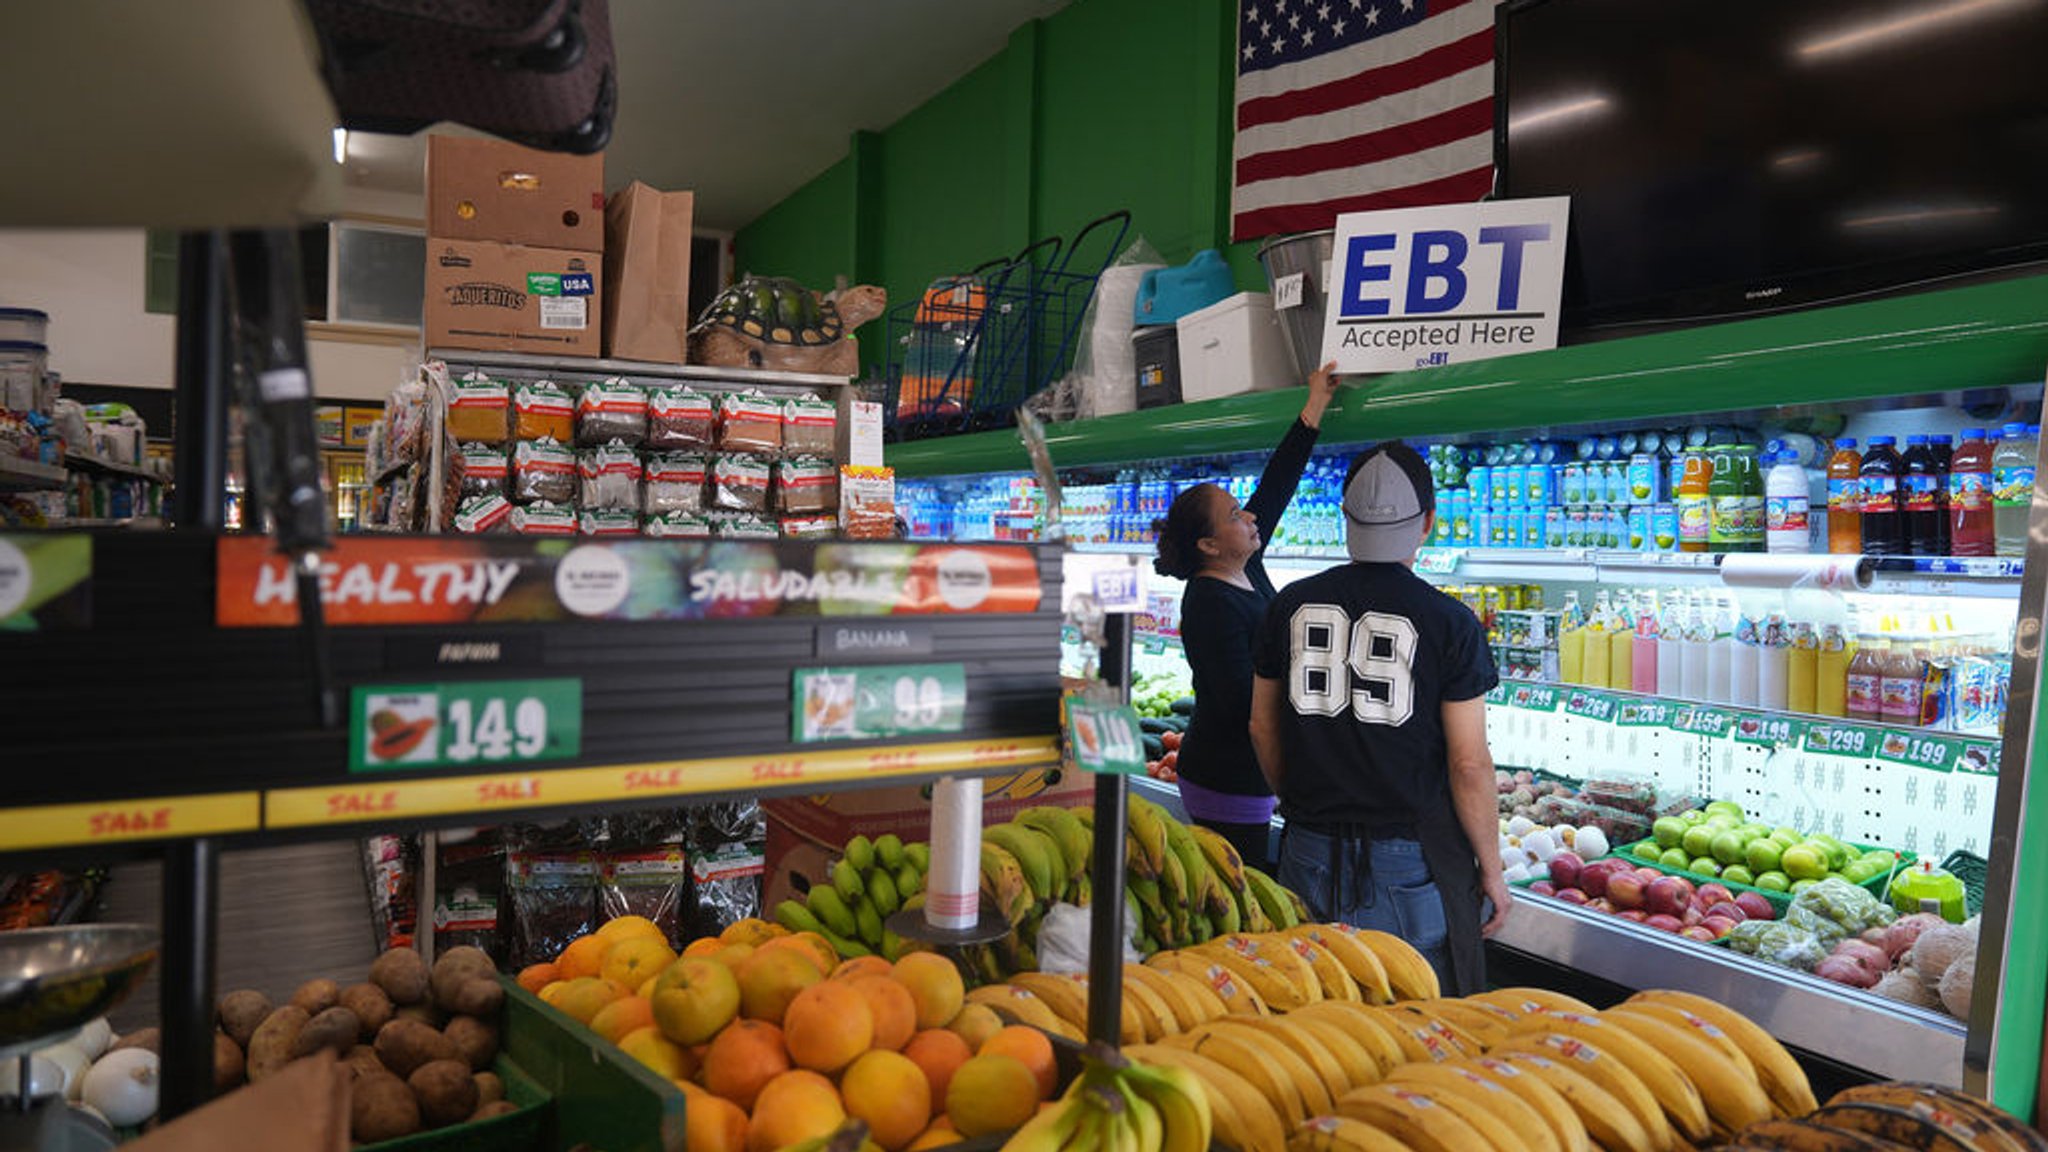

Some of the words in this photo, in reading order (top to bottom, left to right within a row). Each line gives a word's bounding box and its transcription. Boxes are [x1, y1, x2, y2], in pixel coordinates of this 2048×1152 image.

[1340, 224, 1551, 317] EBT
[563, 279, 590, 290] USA
[1342, 322, 1461, 350] Accepted
[1471, 321, 1535, 344] Here
[253, 561, 520, 605] HEALTHY
[1098, 572, 1136, 598] EBT
[836, 628, 910, 650] BANANA
[1289, 604, 1419, 727] 89
[894, 676, 943, 728] 99
[446, 696, 547, 762] 149
[1759, 721, 1791, 741] 199
[1831, 729, 1866, 752] 299
[1908, 738, 1947, 765] 199
[624, 768, 684, 791] SALE
[751, 758, 806, 782] SALE
[326, 790, 399, 816] SALE
